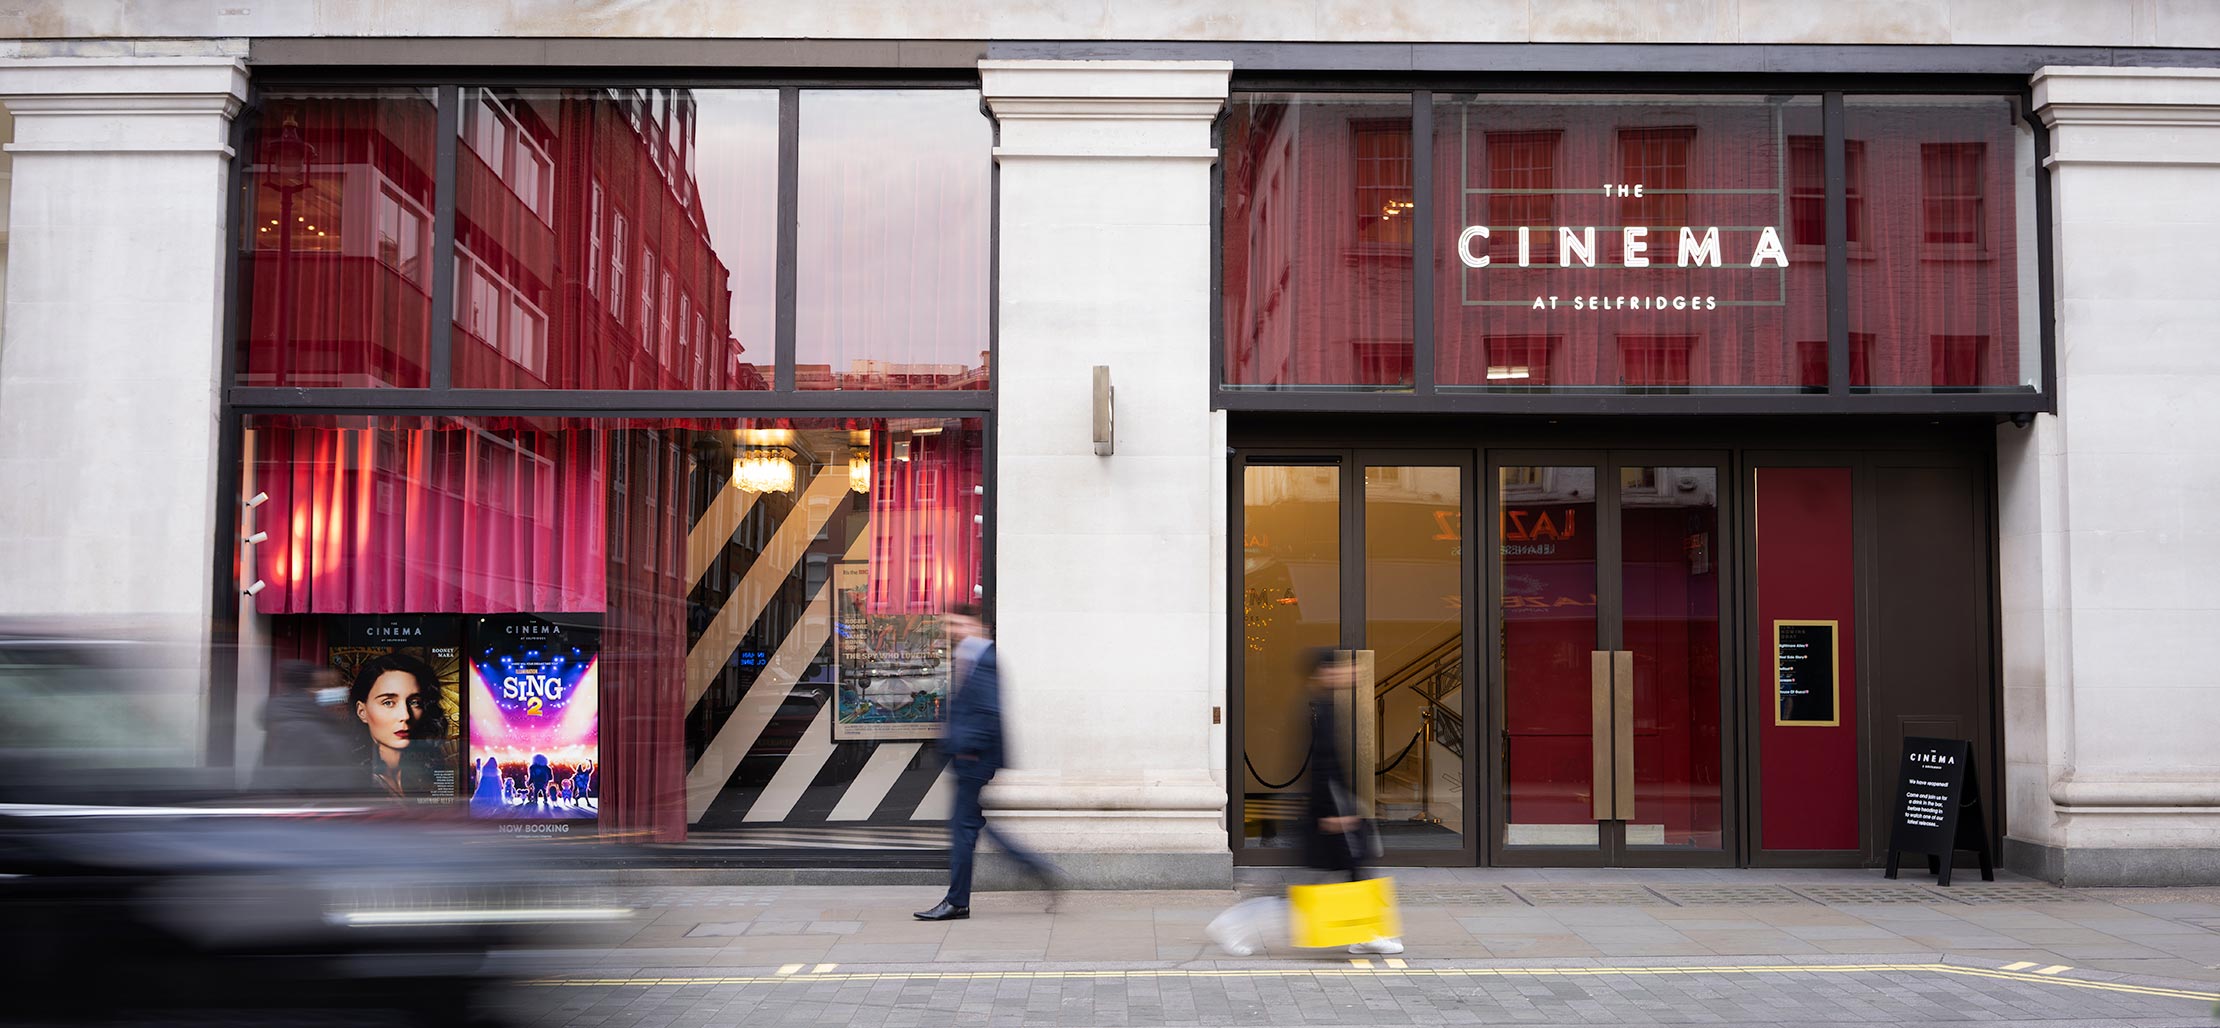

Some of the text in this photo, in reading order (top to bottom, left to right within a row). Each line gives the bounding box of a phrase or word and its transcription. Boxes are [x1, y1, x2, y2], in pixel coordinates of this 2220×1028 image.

[1603, 184, 1644, 198] THE
[1458, 225, 1790, 268] CINEMA
[1532, 296, 1716, 310] AT SELFRIDGES
[366, 627, 422, 636] CINEMA
[506, 626, 560, 634] CINEMA
[503, 675, 564, 702] SING
[527, 696, 543, 717] 2
[1910, 753, 1954, 764] CINEMA
[498, 824, 570, 832] NOW BOOKING
